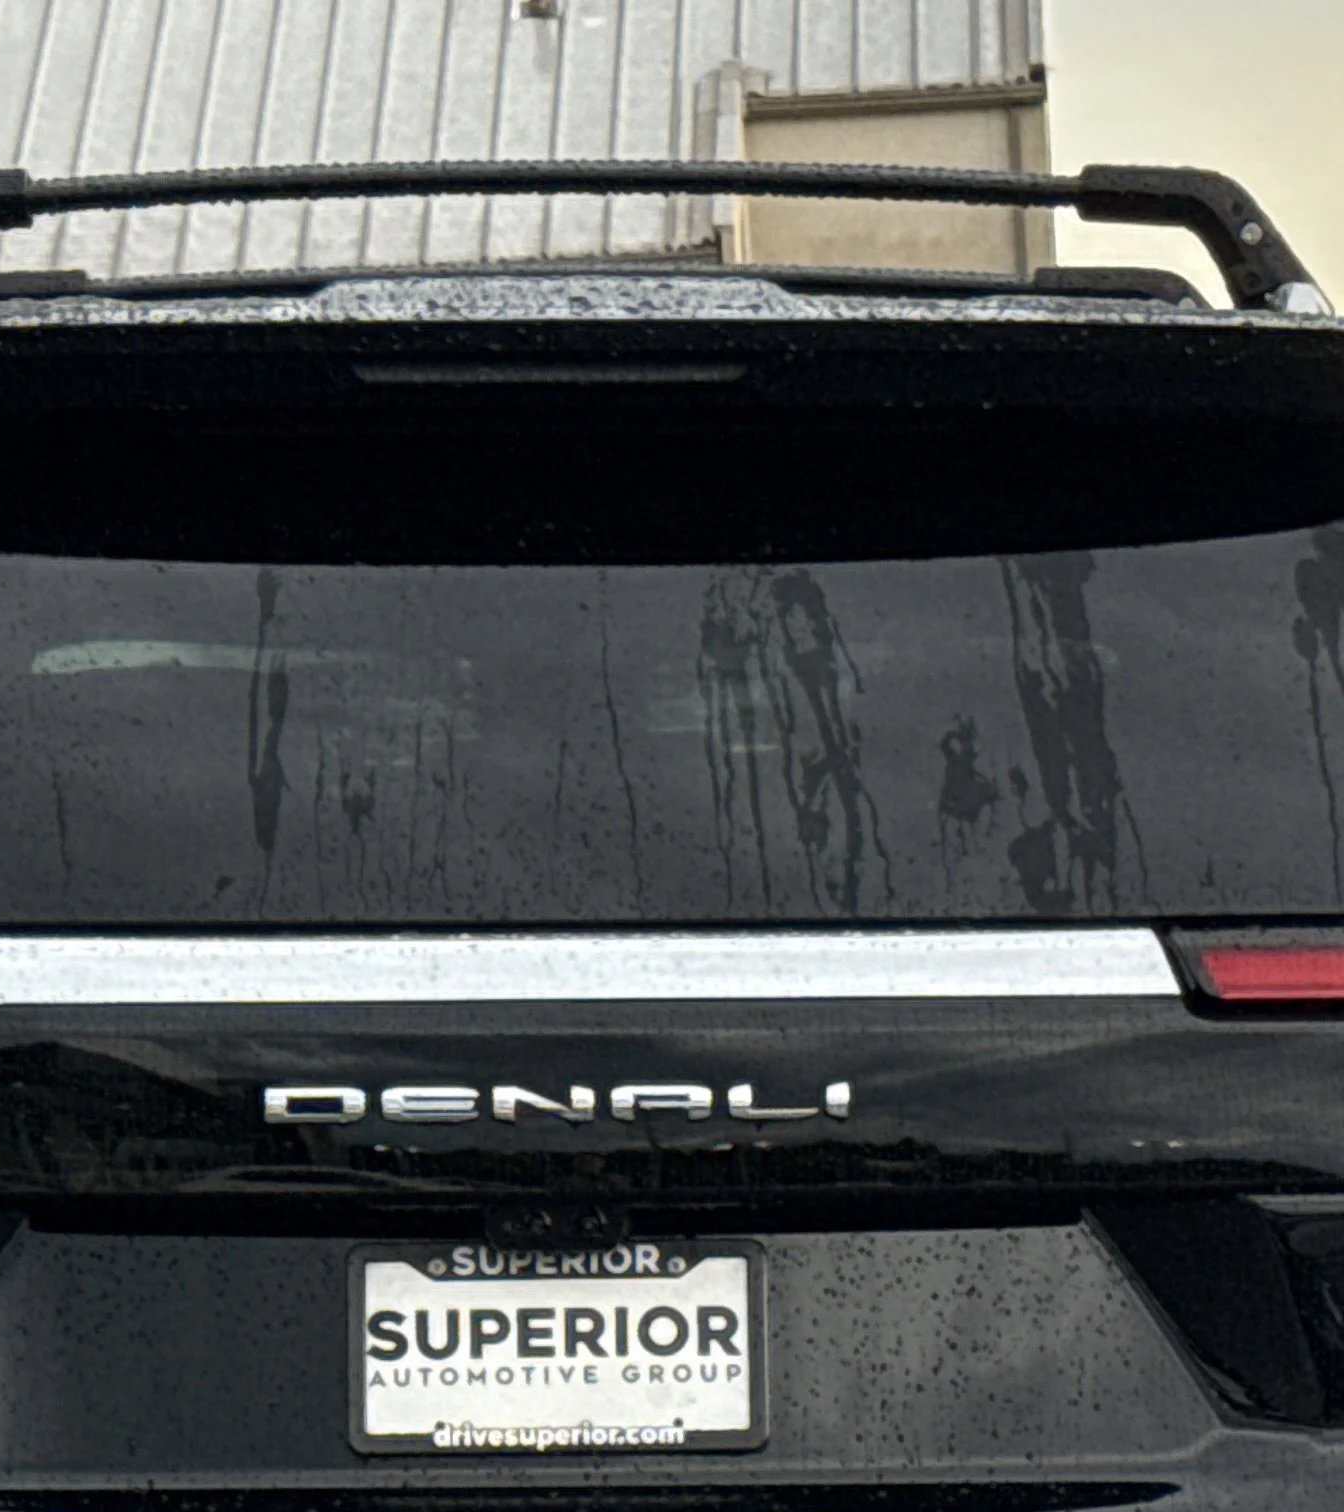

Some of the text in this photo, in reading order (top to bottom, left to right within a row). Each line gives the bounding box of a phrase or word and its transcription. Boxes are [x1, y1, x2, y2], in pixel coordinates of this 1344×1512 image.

[264, 1082, 851, 1123] DENALI
[451, 1244, 661, 1275] SUPERIOR
[366, 1306, 742, 1361] SUPERIOR
[368, 1363, 742, 1388] AUTOMOTIVE GROUP
[432, 1420, 685, 1450] drivesuperior.com
